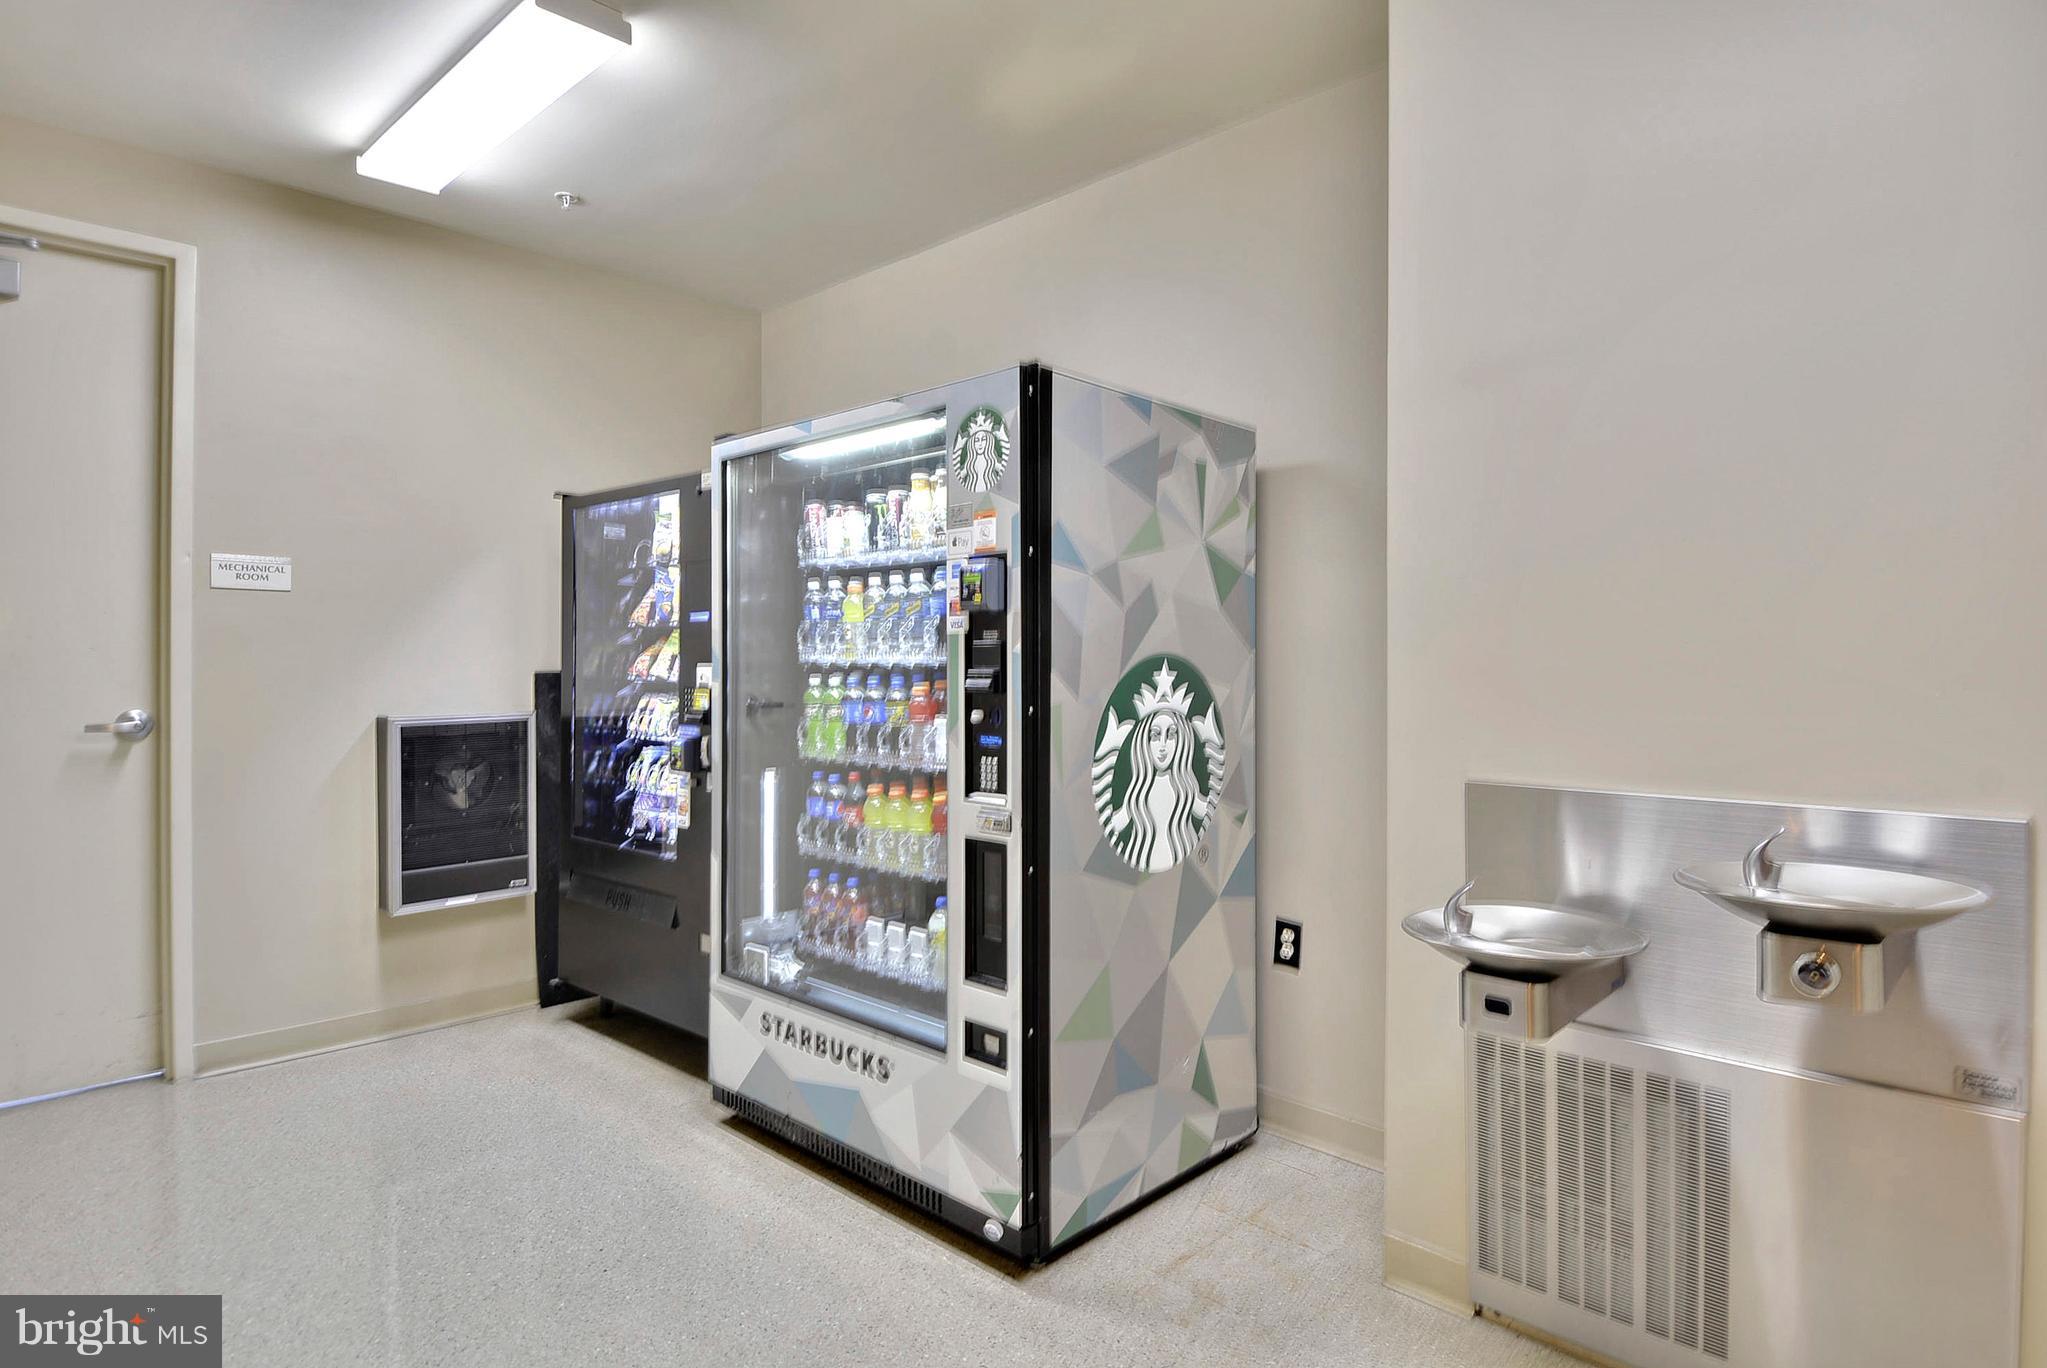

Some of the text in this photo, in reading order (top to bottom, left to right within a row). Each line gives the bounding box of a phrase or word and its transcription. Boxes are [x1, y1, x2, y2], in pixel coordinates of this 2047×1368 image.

[218, 563, 286, 574] MECHANICAL
[235, 572, 269, 582] ROOM
[950, 620, 964, 629] VISA
[604, 888, 632, 912] PUSH
[759, 1011, 891, 1085] STARBUCKS
